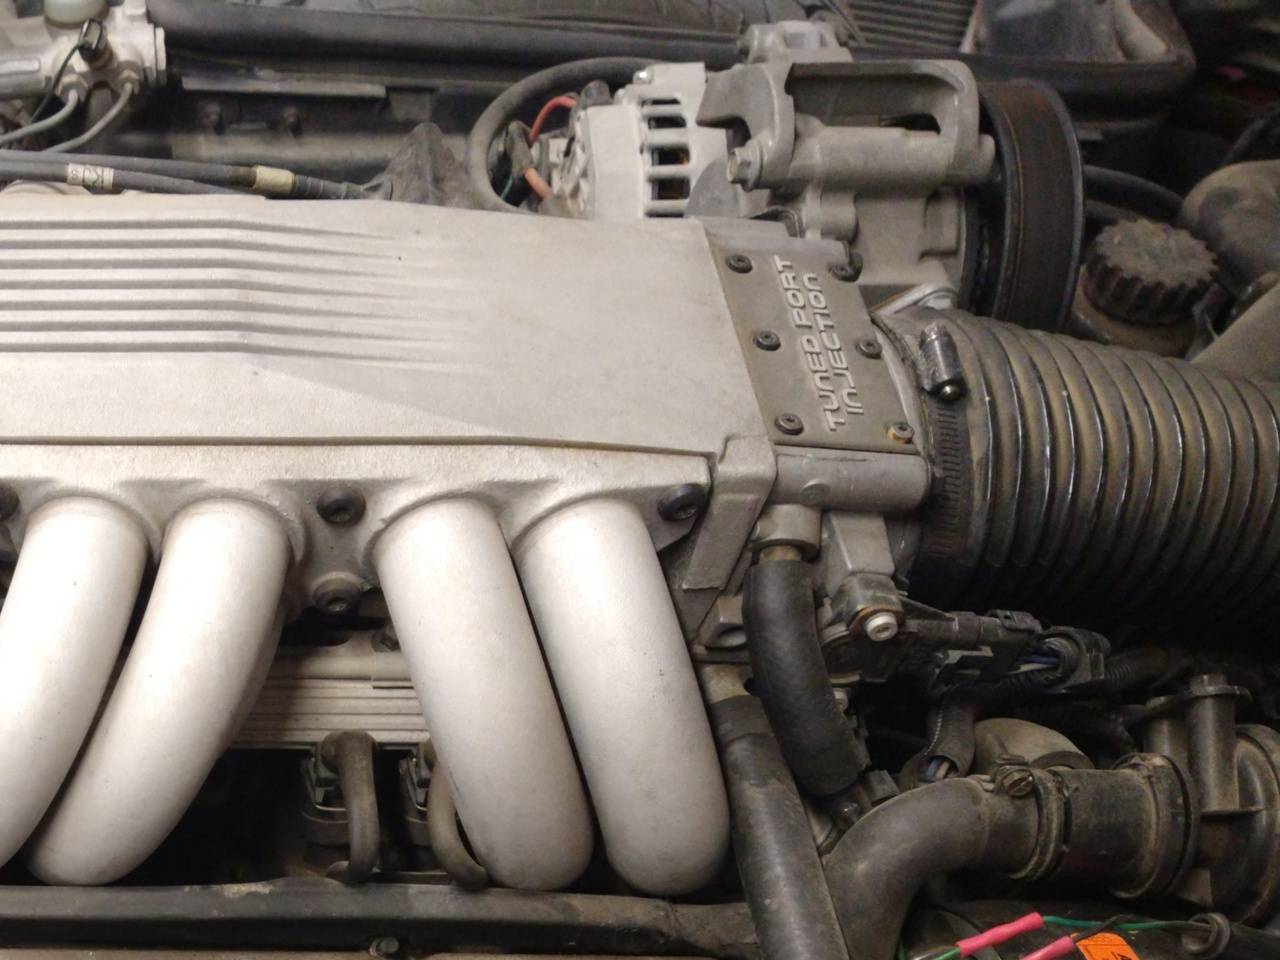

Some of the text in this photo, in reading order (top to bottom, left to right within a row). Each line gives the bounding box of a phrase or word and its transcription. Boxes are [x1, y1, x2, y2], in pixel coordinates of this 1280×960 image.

[774, 255, 846, 431] TUNED PORT
[803, 272, 864, 415] INJECTION
